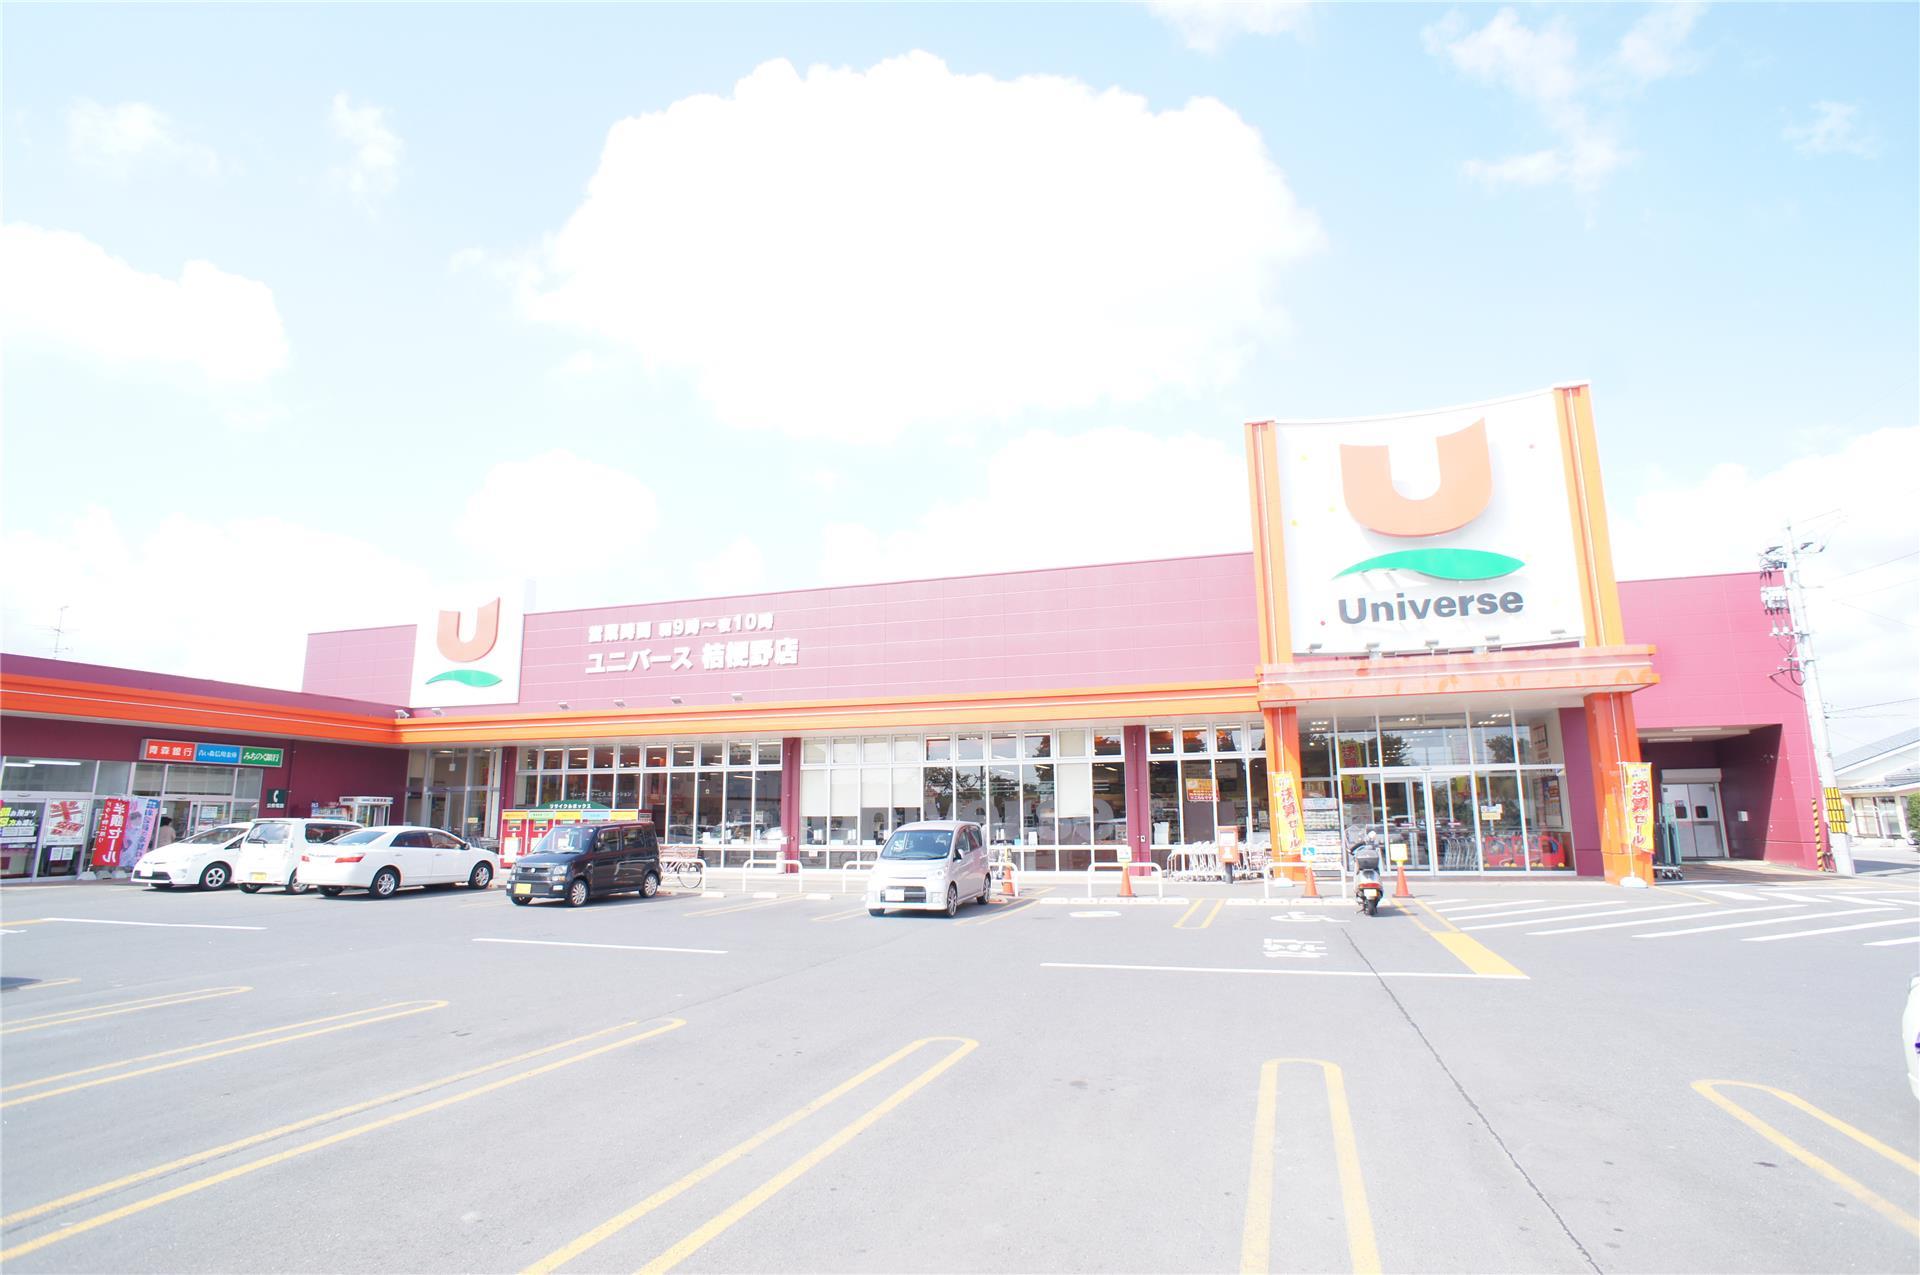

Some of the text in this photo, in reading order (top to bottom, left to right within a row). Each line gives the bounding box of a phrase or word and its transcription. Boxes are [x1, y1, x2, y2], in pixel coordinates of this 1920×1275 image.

[1338, 590, 1524, 625] Universe
[588, 621, 652, 643] 営業時間
[585, 637, 799, 675] ユニバース 桔梗野店
[148, 745, 193, 757] 青森銀行
[243, 751, 279, 762] みちのく銀行
[1281, 787, 1302, 849] 決算セール
[1631, 780, 1649, 844] 決算セール
